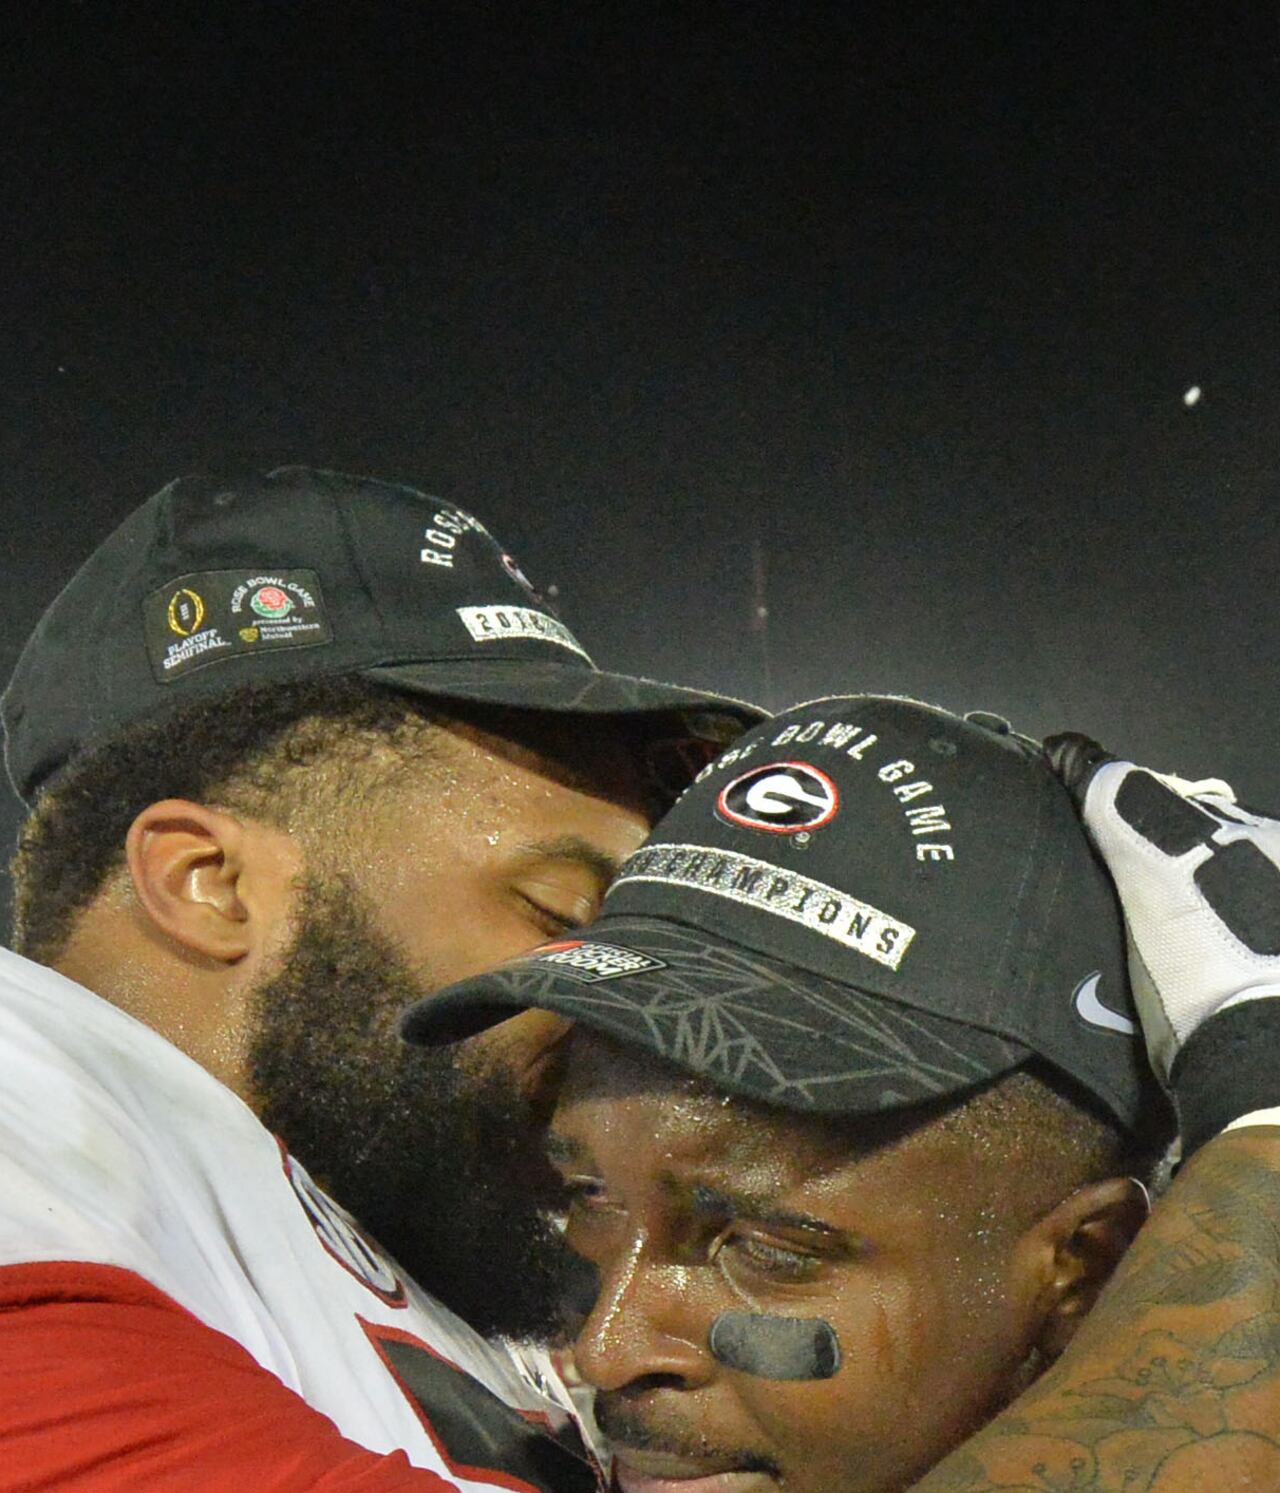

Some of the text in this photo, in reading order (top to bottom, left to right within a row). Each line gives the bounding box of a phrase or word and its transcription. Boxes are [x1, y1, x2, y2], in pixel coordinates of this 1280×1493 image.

[246, 577, 287, 588] BOWL
[287, 582, 316, 608] GAME
[163, 637, 226, 669] SEMIFINAL
[168, 628, 218, 655] PLAYOFF
[771, 721, 878, 761] BOWL
[878, 759, 955, 861] GAME
[668, 851, 900, 955] CHAMPIONS
